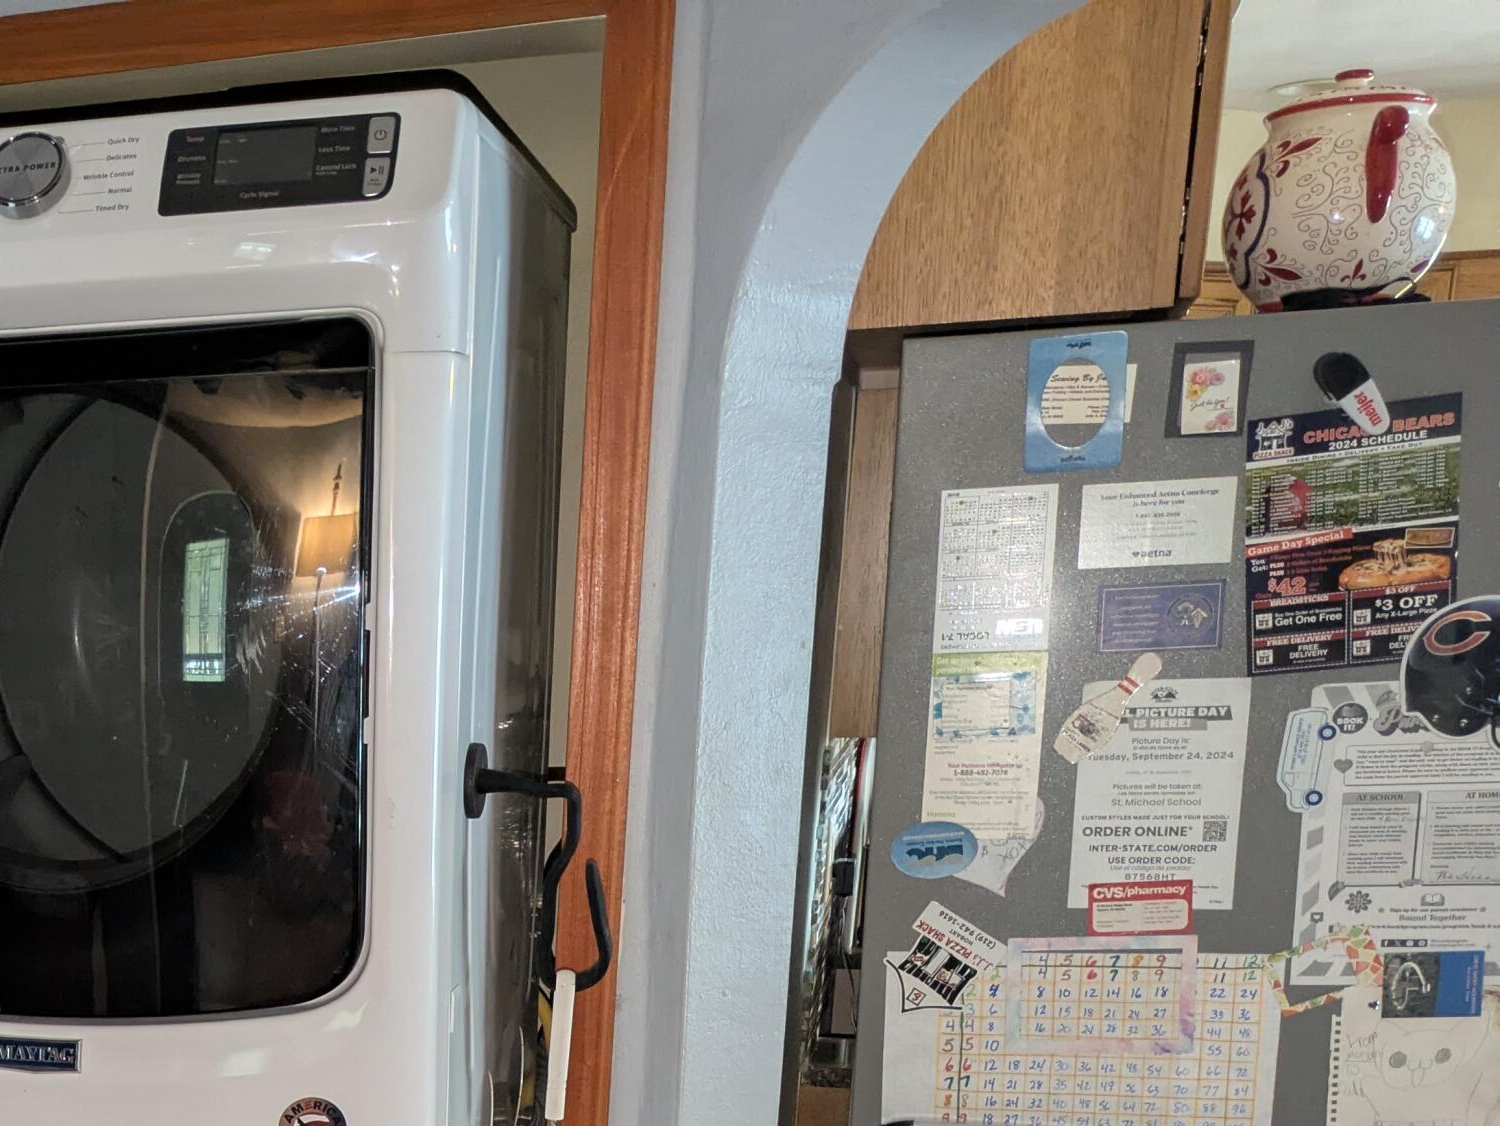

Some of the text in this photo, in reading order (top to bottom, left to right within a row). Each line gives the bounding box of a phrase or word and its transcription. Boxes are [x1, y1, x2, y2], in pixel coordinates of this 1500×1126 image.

[107, 136, 140, 145] Quick Dry
[106, 153, 137, 161] Delicates
[23, 161, 57, 172] POWER
[83, 170, 134, 180] Wrinkle Control
[95, 204, 116, 212] Timed
[1051, 374, 1080, 384] Sewing
[1354, 391, 1383, 427] meijer
[1303, 412, 1455, 444] CHICA BEARS
[1328, 429, 1428, 451] 2024 SCHEDULE
[1247, 530, 1344, 556] Game Day Special
[1268, 576, 1306, 596] $42
[1269, 595, 1329, 607] BREADSTICKS
[1375, 594, 1438, 611] $3 OFF
[1274, 612, 1343, 627] Get One Free
[1365, 629, 1389, 637] FREE
[1290, 634, 1333, 644] DELIVERY
[1298, 643, 1320, 652] FREE
[1289, 649, 1328, 659] DELIVERY
[1135, 706, 1228, 718] PICTURE DAY
[1133, 718, 1191, 728] IS HERE!
[1336, 717, 1364, 725] BOOK
[1132, 737, 1161, 745] Picture
[1163, 737, 1179, 745] Day
[1132, 752, 1184, 762] September
[1186, 752, 1203, 761] 24,
[1206, 751, 1234, 760] 2024
[1112, 783, 1143, 791] Pictures
[1124, 798, 1165, 806] Michael
[1167, 798, 1202, 806] School
[1082, 826, 1131, 837] ORDER
[1088, 844, 1218, 853] INTER-STATE.COM/ORDER
[1092, 884, 1187, 900] CVS/pharmacy
[916, 920, 946, 941] SHACK
[939, 910, 996, 950] (219) 942-1616
[945, 937, 972, 959] PIZZA
[284, 1101, 340, 1124] AMERICA
